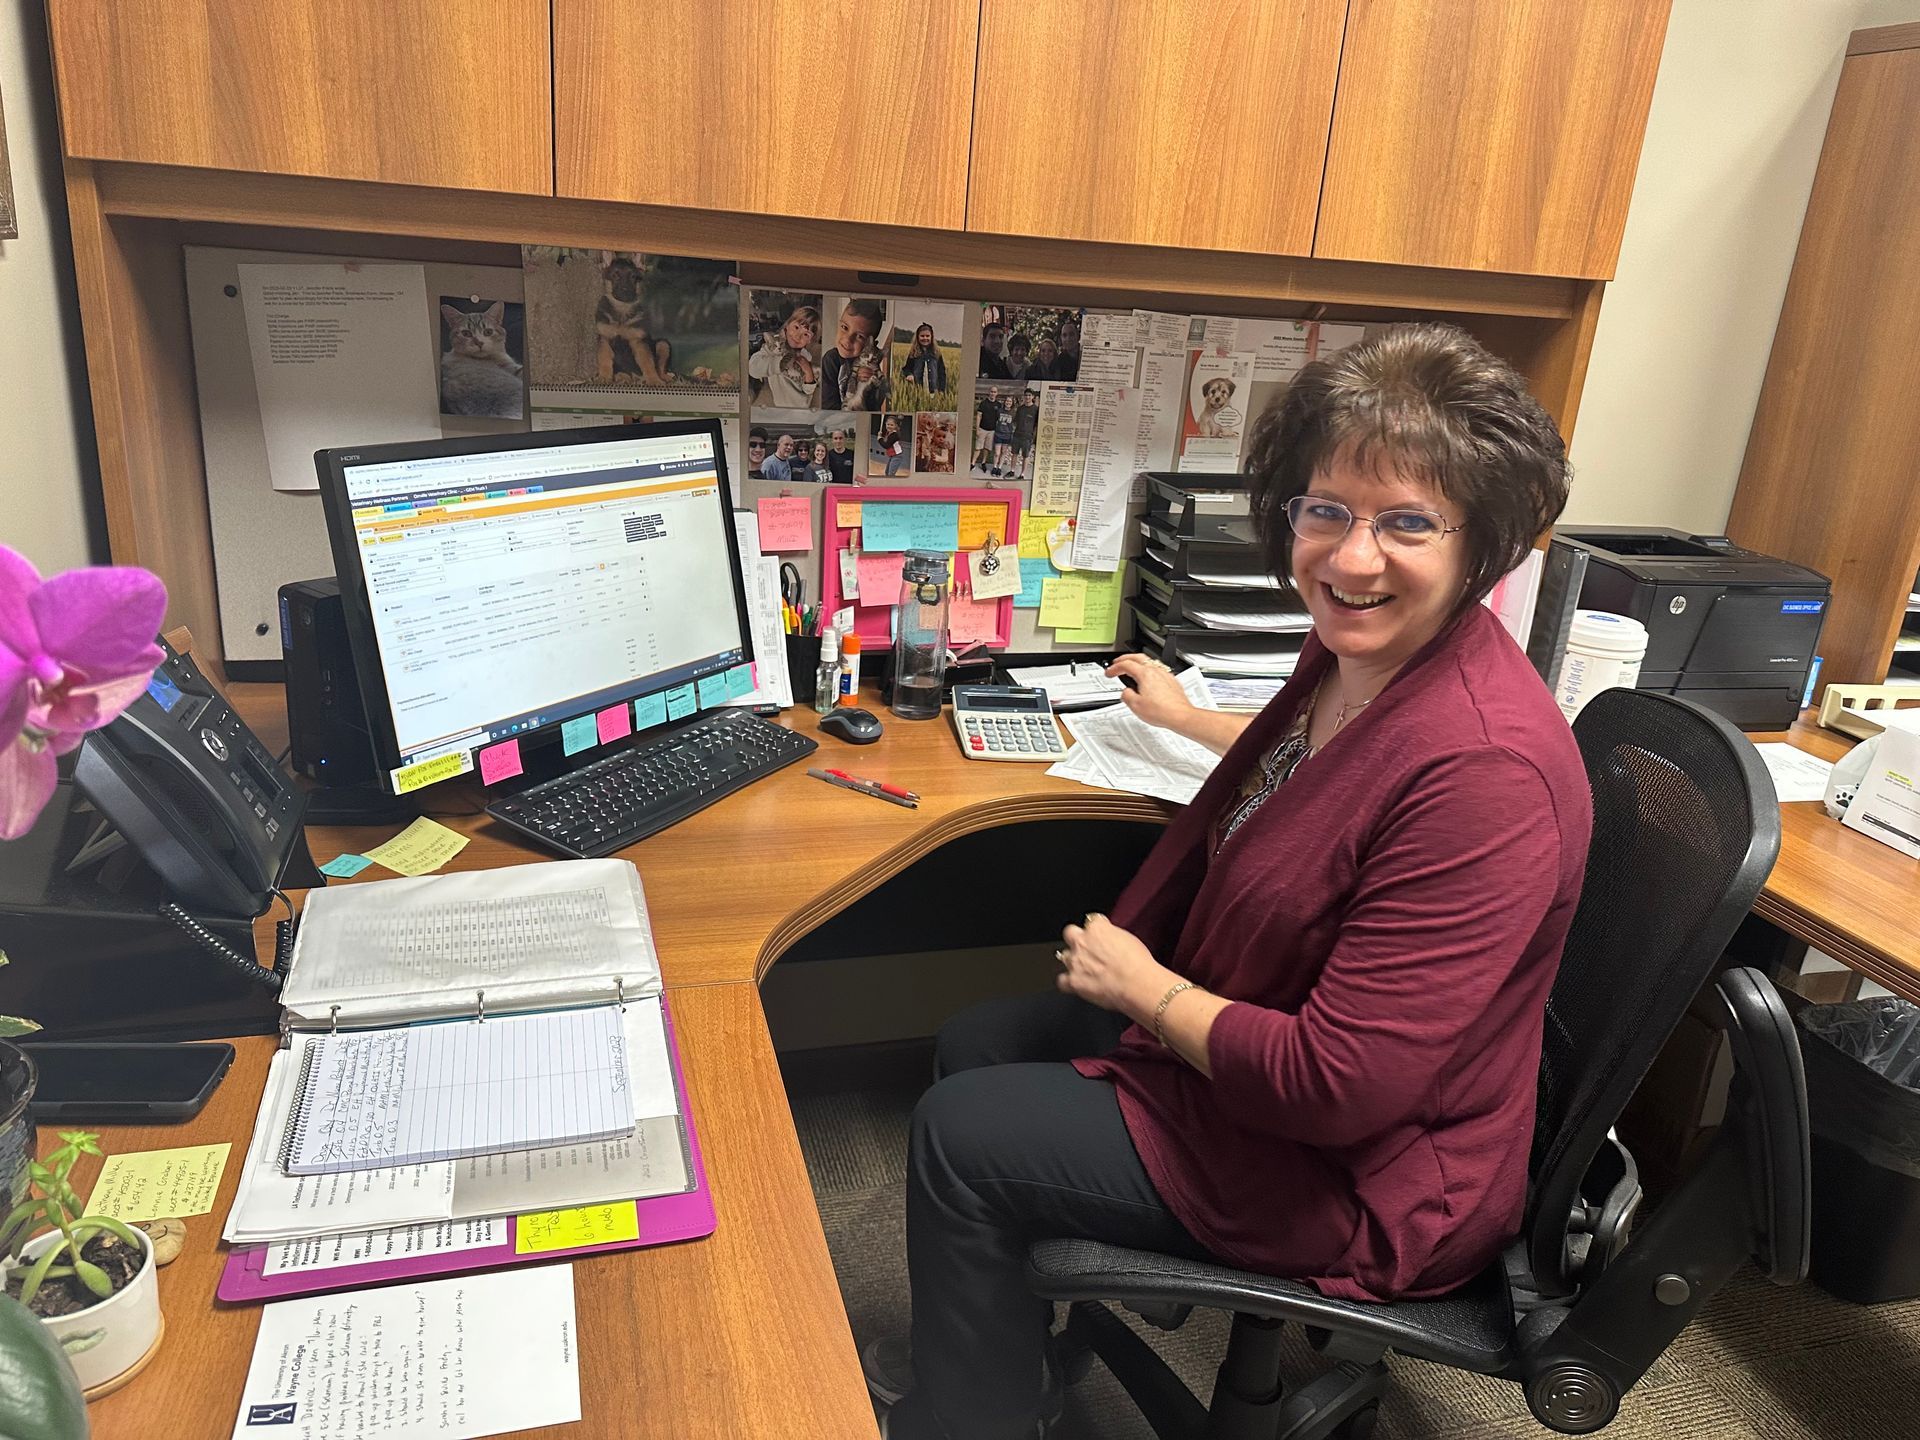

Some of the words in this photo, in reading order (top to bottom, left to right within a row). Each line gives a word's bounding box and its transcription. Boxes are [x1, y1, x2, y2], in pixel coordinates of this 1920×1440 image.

[280, 1344, 289, 1359] Akron
[291, 1345, 306, 1372] College
[274, 1365, 287, 1389] University
[286, 1373, 300, 1398] Wayne
